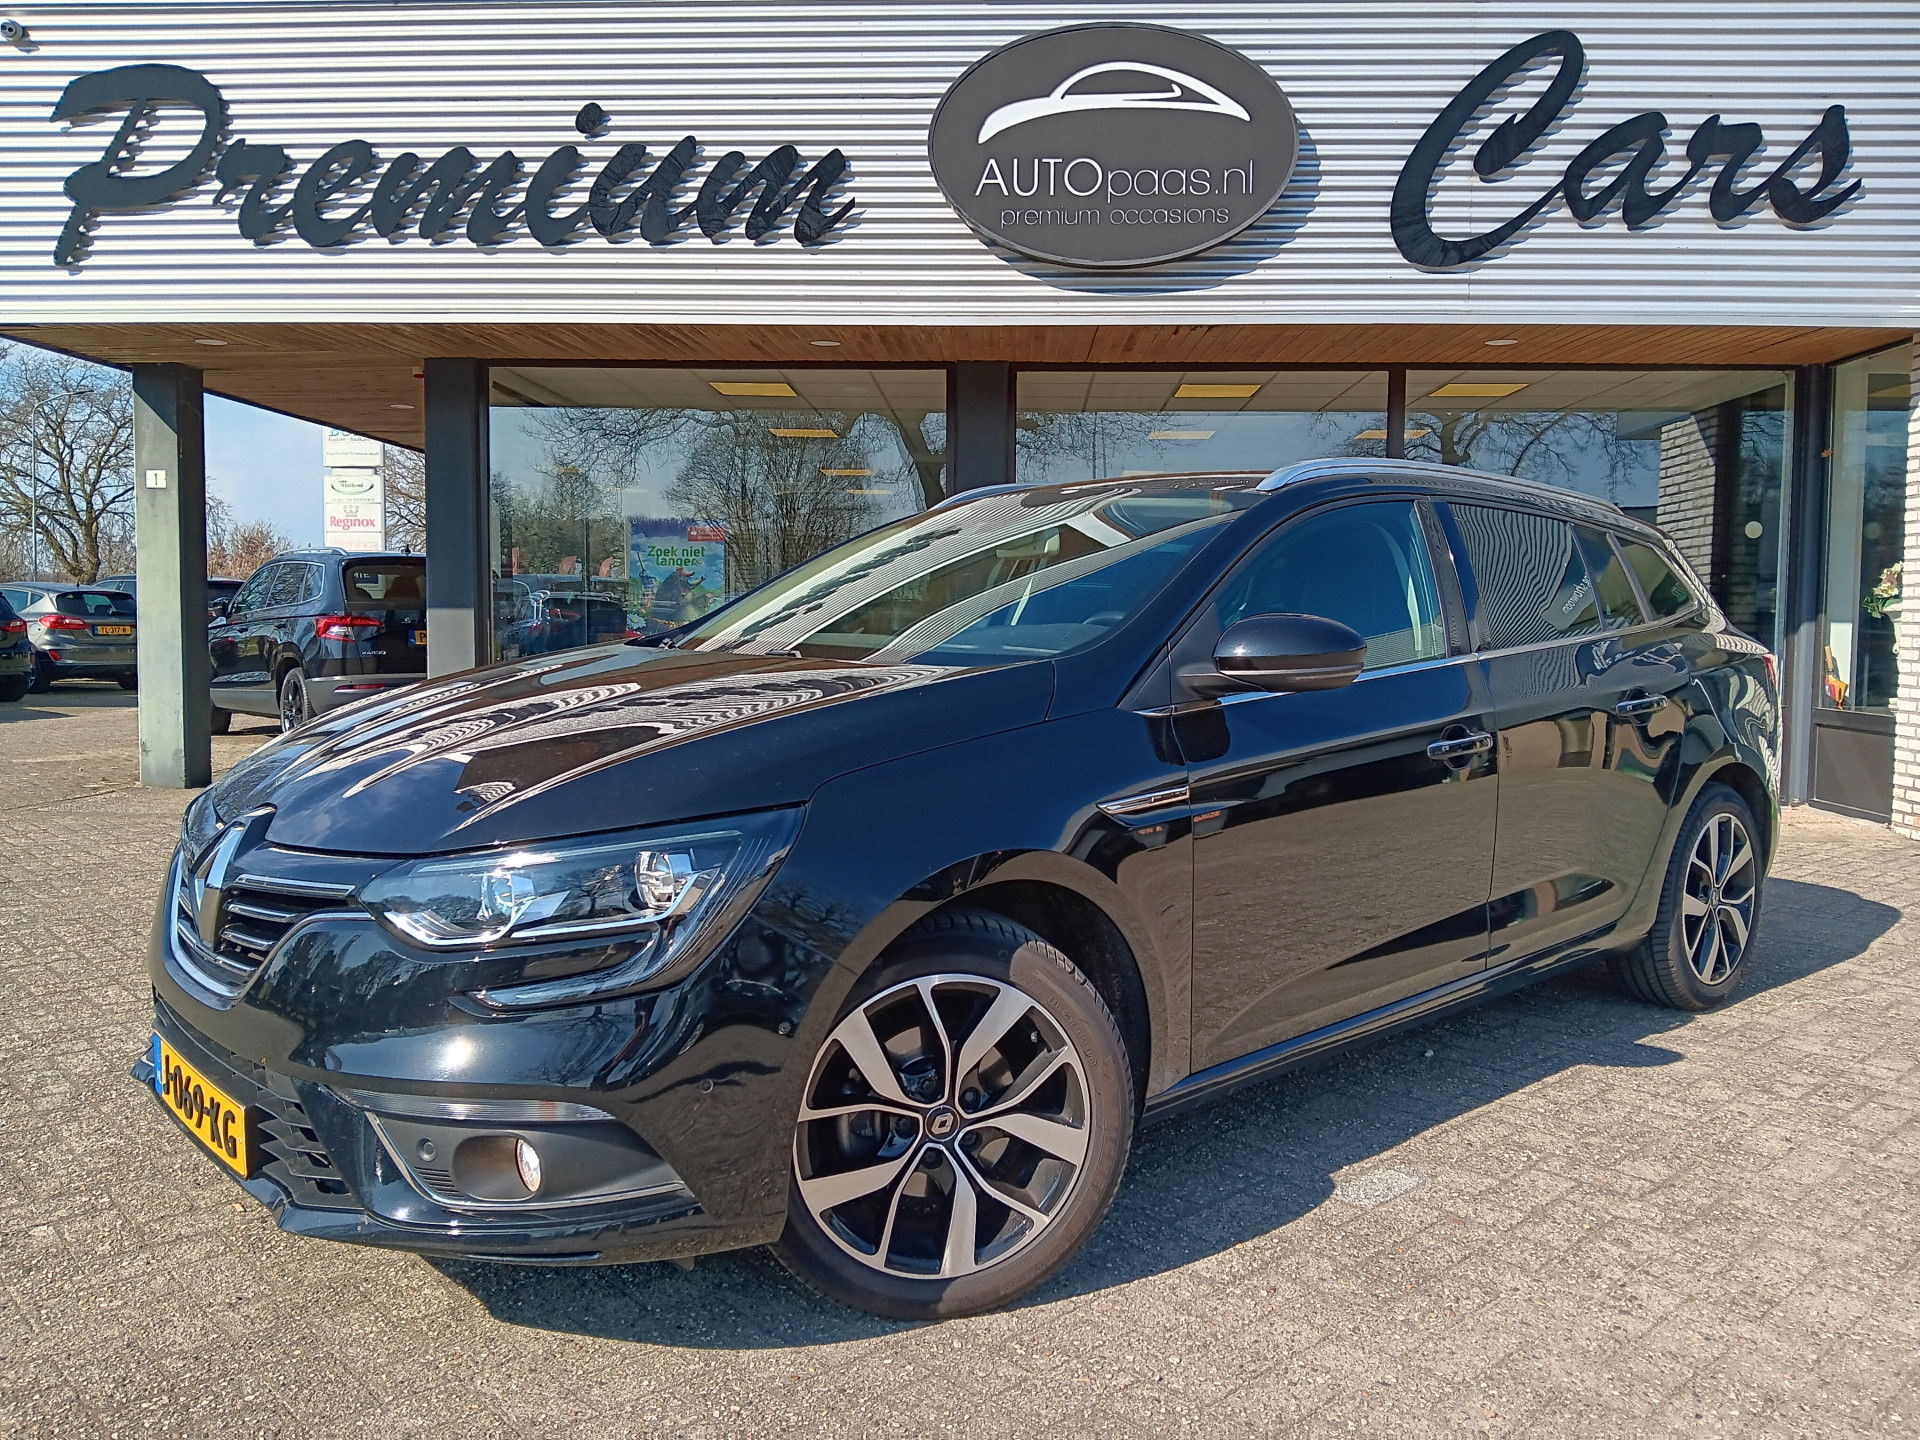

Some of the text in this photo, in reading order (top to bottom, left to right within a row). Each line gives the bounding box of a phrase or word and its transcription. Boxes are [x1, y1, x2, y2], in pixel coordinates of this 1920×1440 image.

[52, 30, 1862, 268] Premium Cars
[975, 157, 1254, 203] AUTOpaas.nl
[1000, 205, 1230, 228] premium occasions
[330, 516, 376, 530] Reginox
[648, 545, 706, 557] Zoek niet
[163, 1055, 238, 1159] J-069-KG
